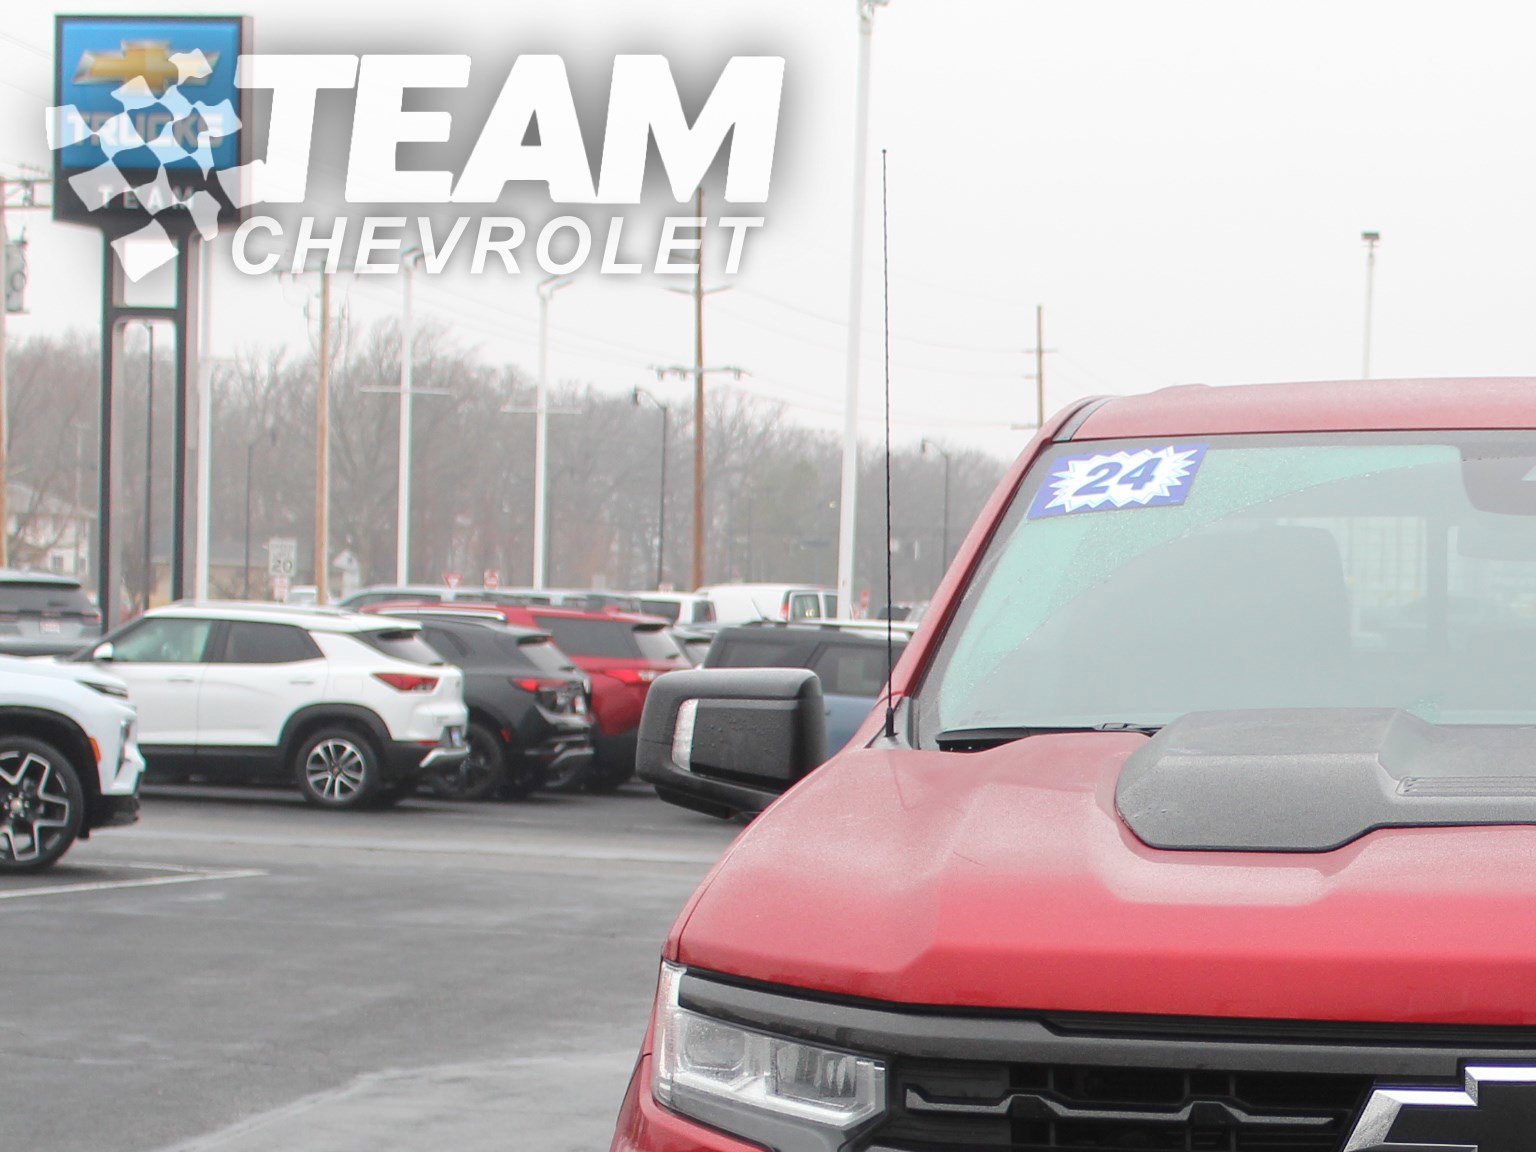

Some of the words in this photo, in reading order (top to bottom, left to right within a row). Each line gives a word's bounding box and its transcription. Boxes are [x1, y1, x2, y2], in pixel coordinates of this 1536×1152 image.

[66, 111, 226, 148] TRUCKS
[97, 185, 196, 210] TEAM
[1071, 457, 1164, 497] 24
